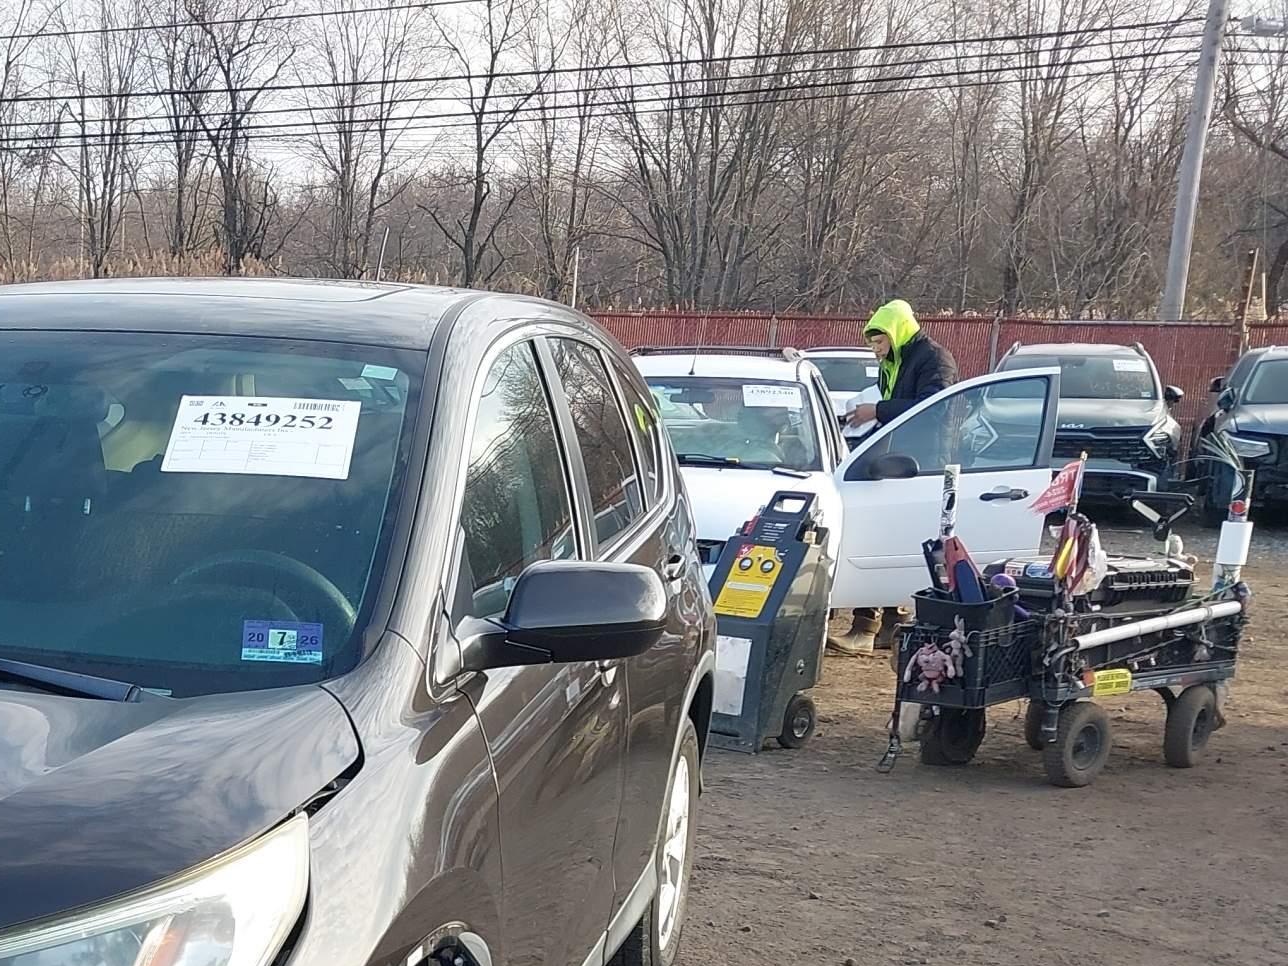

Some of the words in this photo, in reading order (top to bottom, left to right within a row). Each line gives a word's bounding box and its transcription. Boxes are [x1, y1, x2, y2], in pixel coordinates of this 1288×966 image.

[193, 412, 333, 430] 43849252
[248, 632, 264, 643] 20
[277, 631, 287, 646] 7
[299, 635, 319, 646] 26
